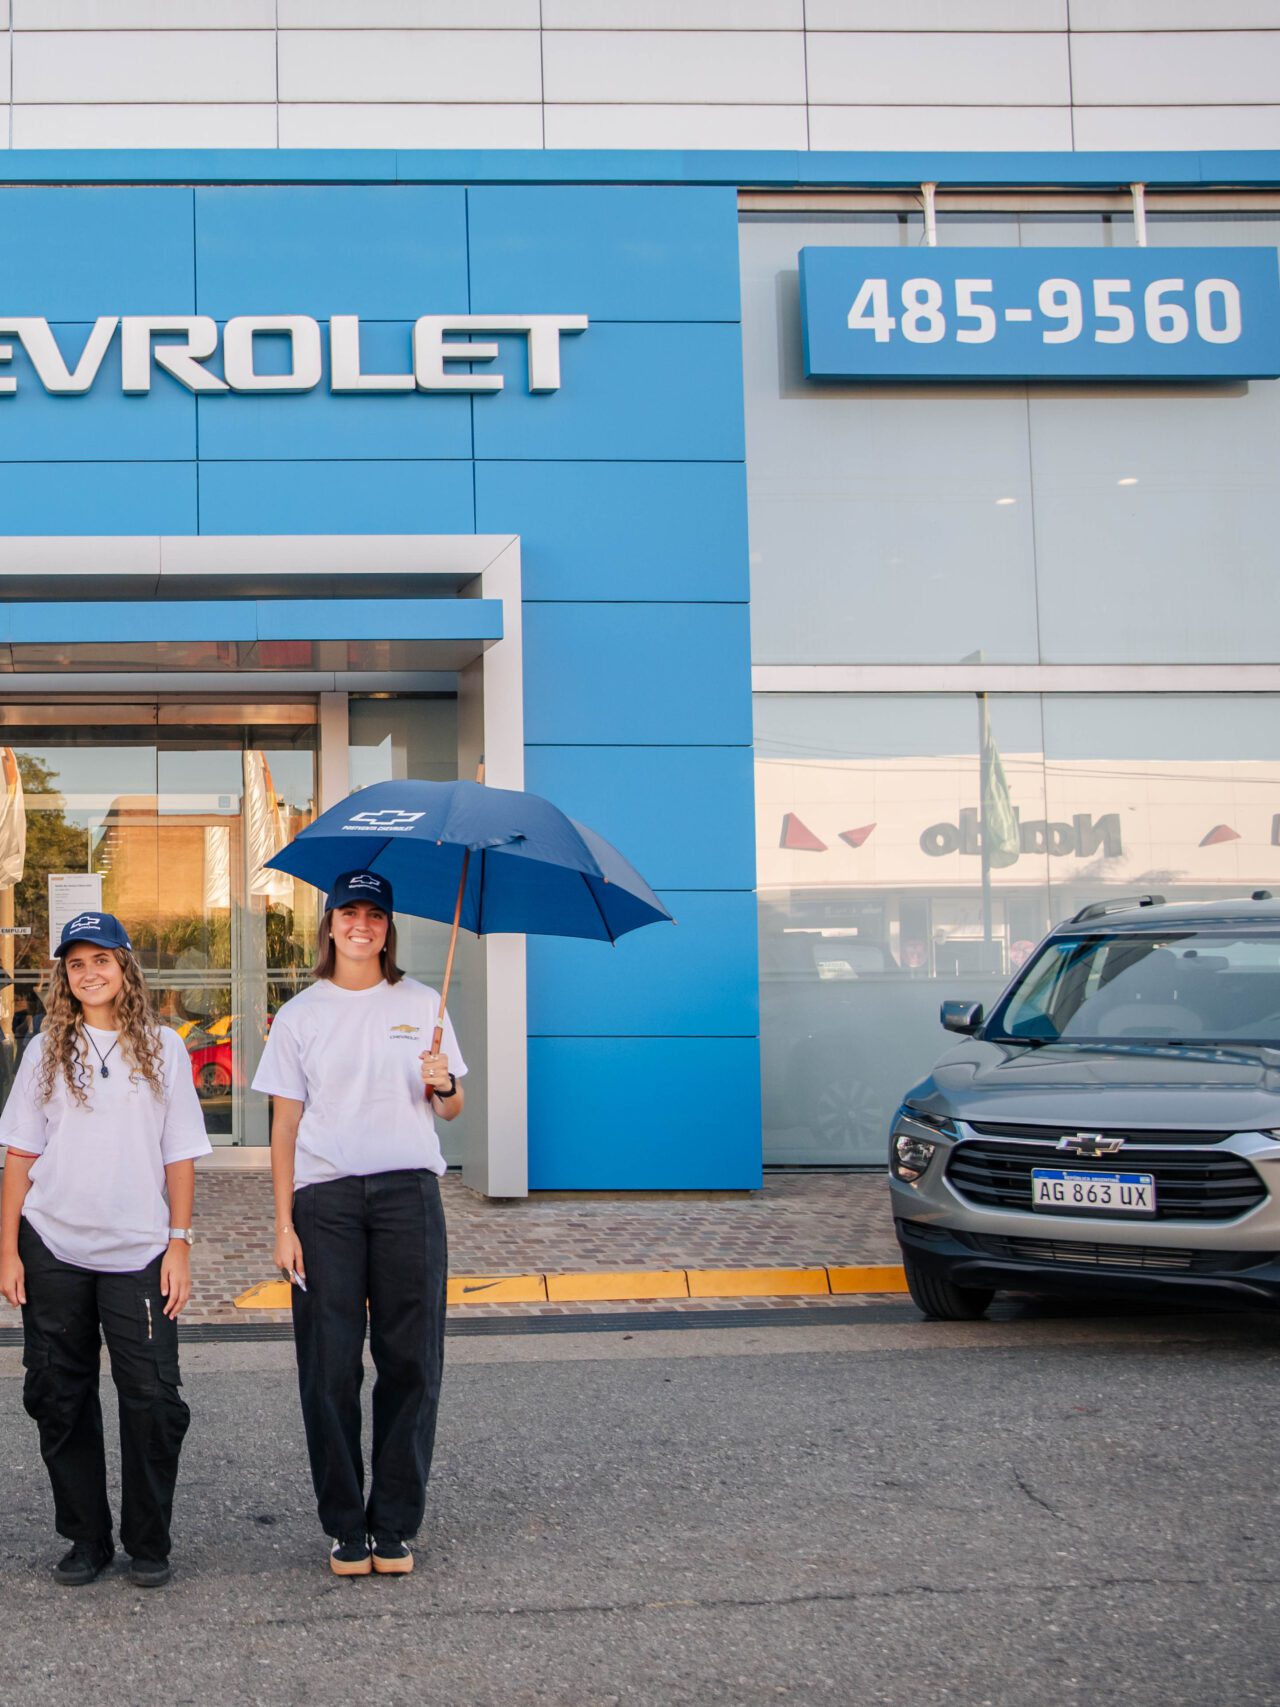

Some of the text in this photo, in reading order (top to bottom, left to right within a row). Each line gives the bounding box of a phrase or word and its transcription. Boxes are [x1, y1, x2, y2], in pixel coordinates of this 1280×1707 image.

[846, 277, 1242, 344] 485-9560
[1040, 1182, 1147, 1206] AG 863 UX
